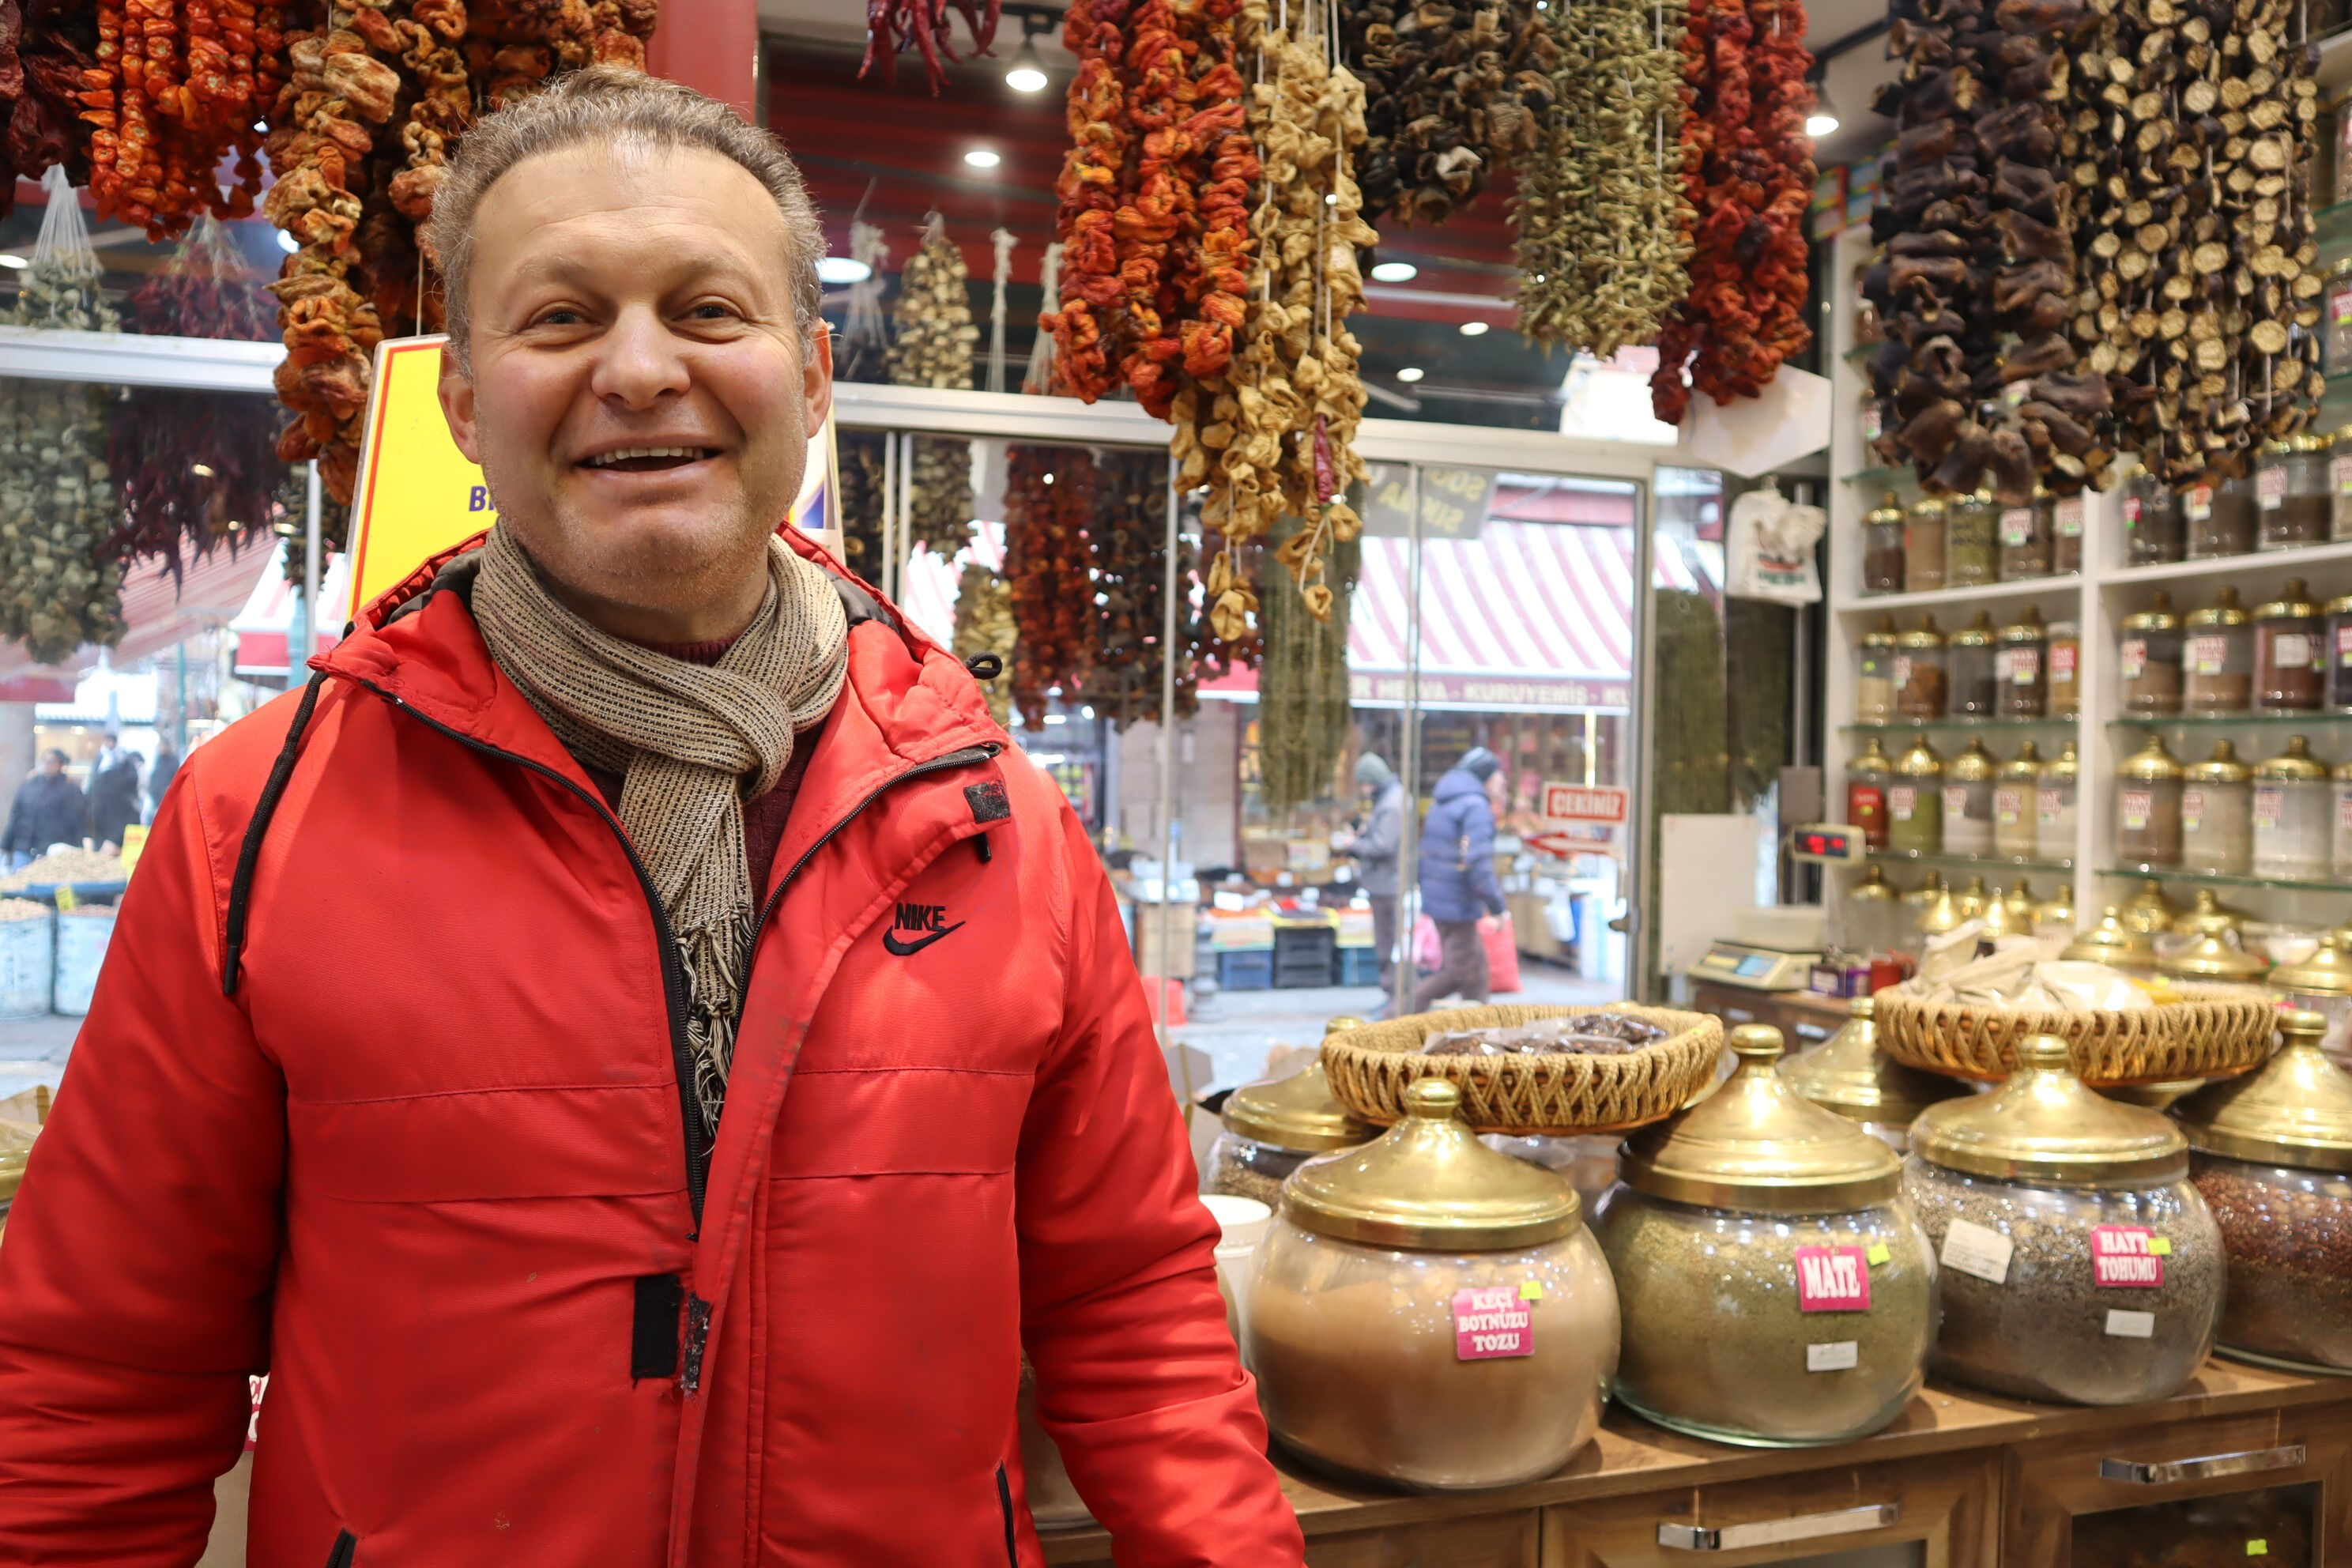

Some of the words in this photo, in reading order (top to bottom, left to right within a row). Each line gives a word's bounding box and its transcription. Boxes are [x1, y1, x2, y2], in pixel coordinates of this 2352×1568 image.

[469, 485, 496, 512] B
[1377, 678, 1449, 702] HEVA
[894, 903, 947, 932] NIKE
[2101, 1231, 2150, 1255] HAYT
[1802, 1254, 1861, 1300] MATE
[2098, 1255, 2158, 1282] TOHUMU
[1472, 1288, 1515, 1313] KEÇİ
[1458, 1311, 1529, 1333] BOYNUZU
[1472, 1332, 1521, 1353] TOZU
